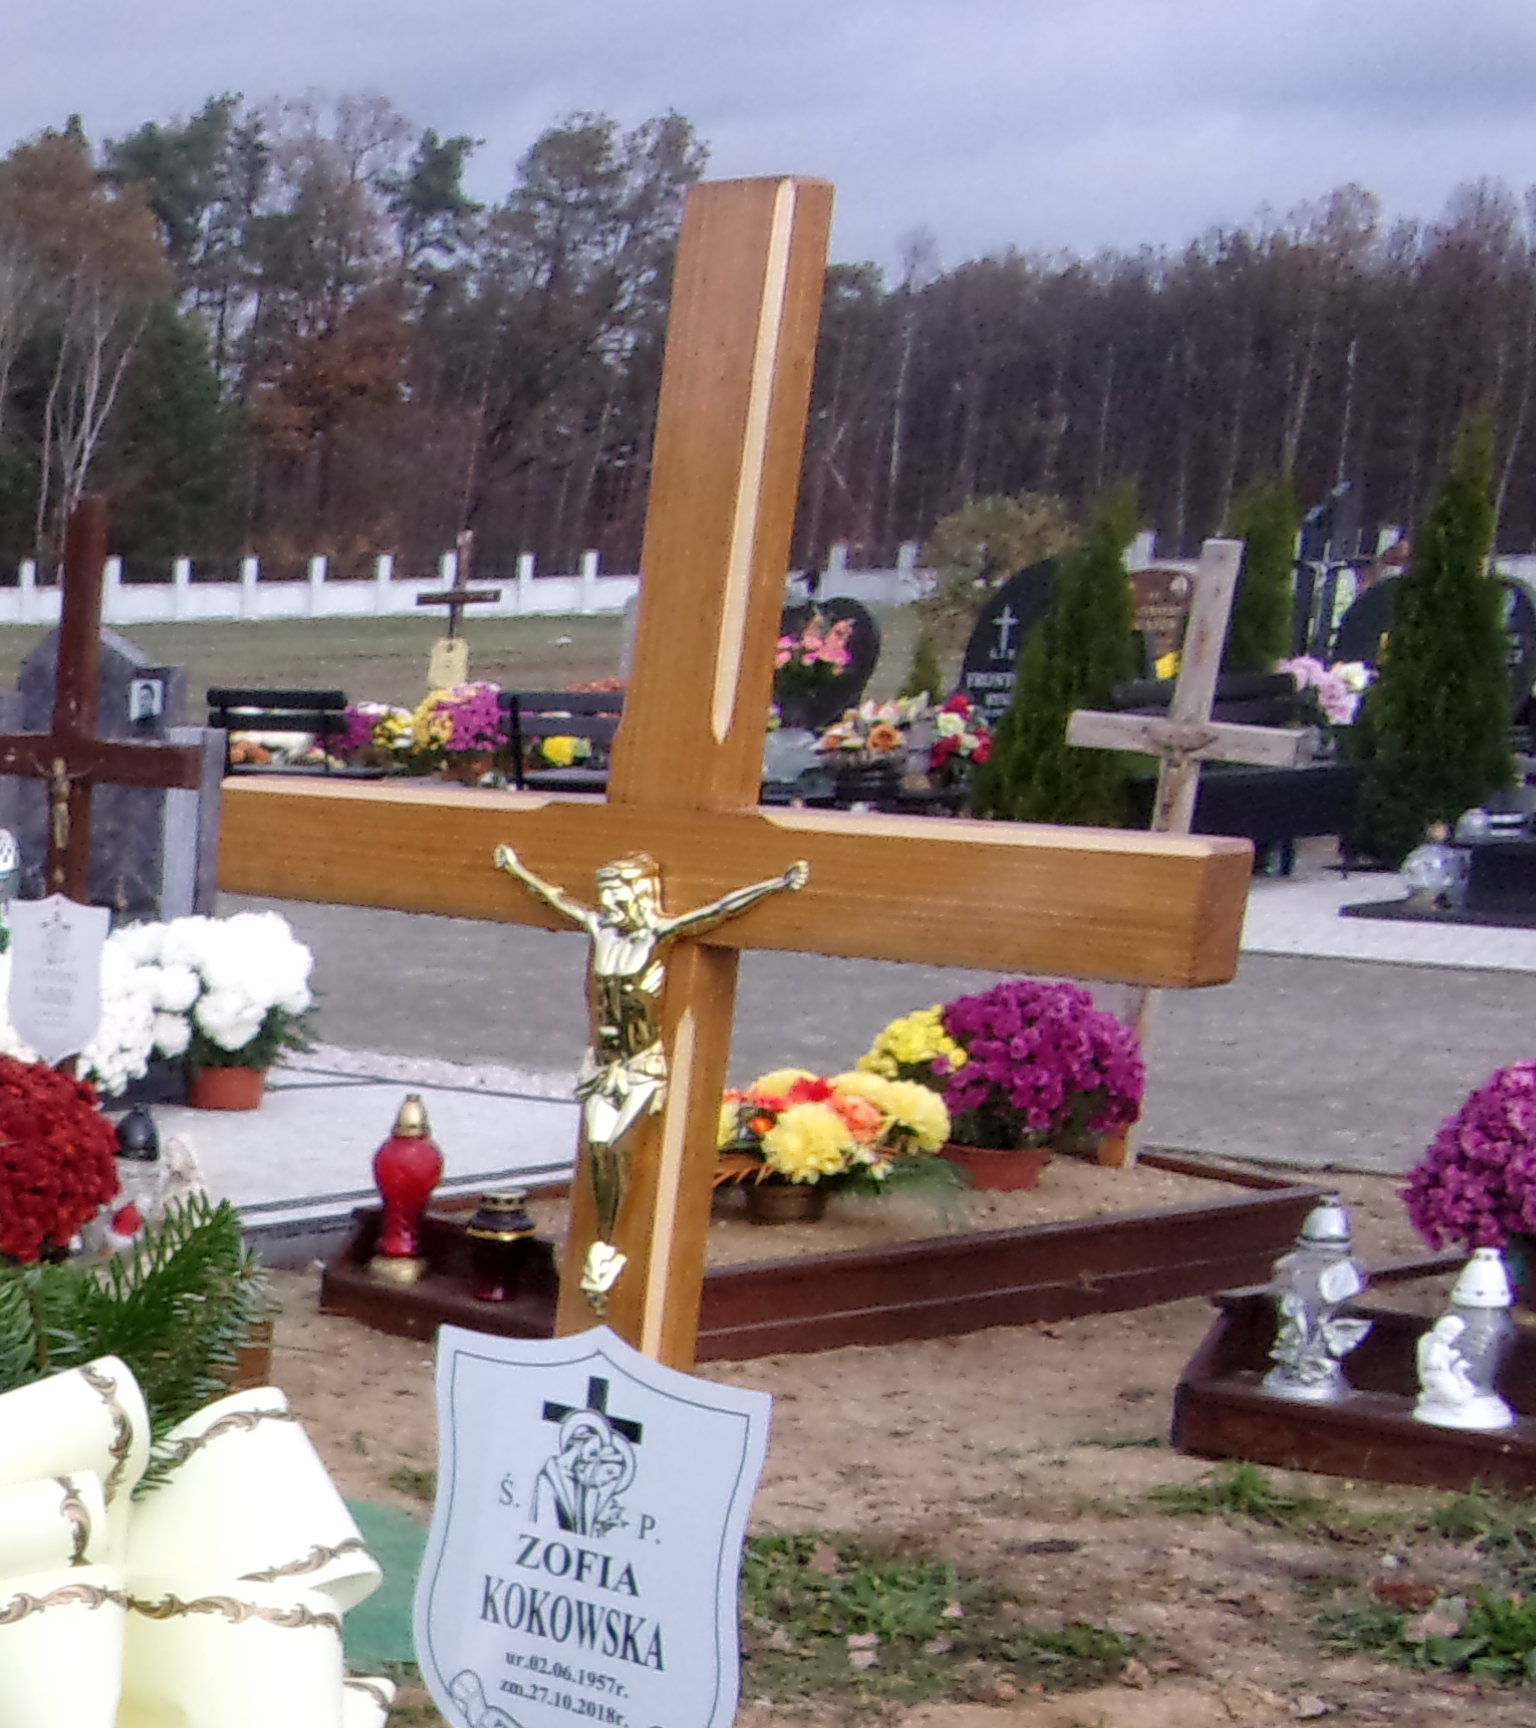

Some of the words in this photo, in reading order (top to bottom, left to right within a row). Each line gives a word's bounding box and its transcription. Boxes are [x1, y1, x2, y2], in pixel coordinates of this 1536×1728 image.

[637, 1512, 661, 1545] P.
[514, 1533, 641, 1598] ZOFIA
[479, 1574, 665, 1672] KOKOWSKA
[505, 1651, 630, 1699] ur.02.06.1957r.
[499, 1678, 629, 1728] zm.27.10.2018r.
